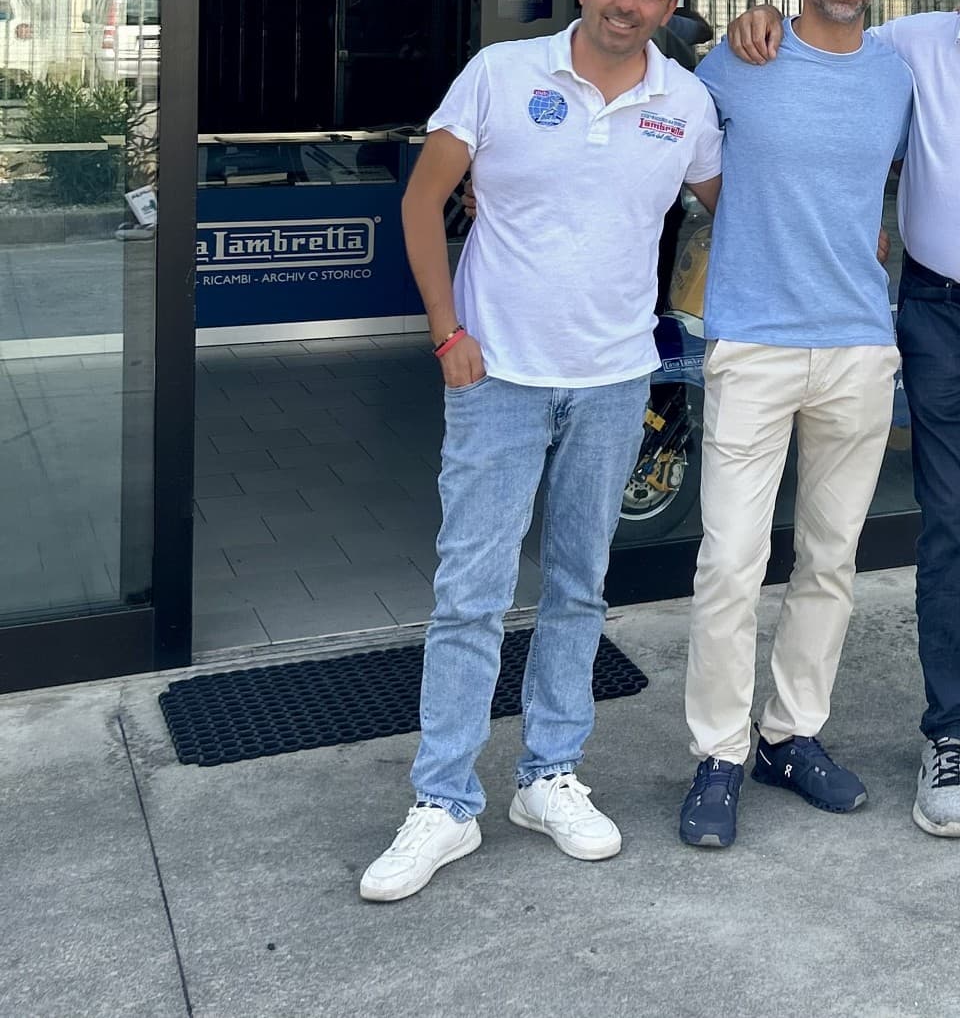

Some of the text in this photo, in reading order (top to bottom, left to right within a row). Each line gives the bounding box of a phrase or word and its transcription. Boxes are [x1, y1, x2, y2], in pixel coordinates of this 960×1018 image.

[212, 226, 366, 261] Lambretta
[203, 275, 251, 286] RICAMBI
[321, 269, 372, 280] STORICO
